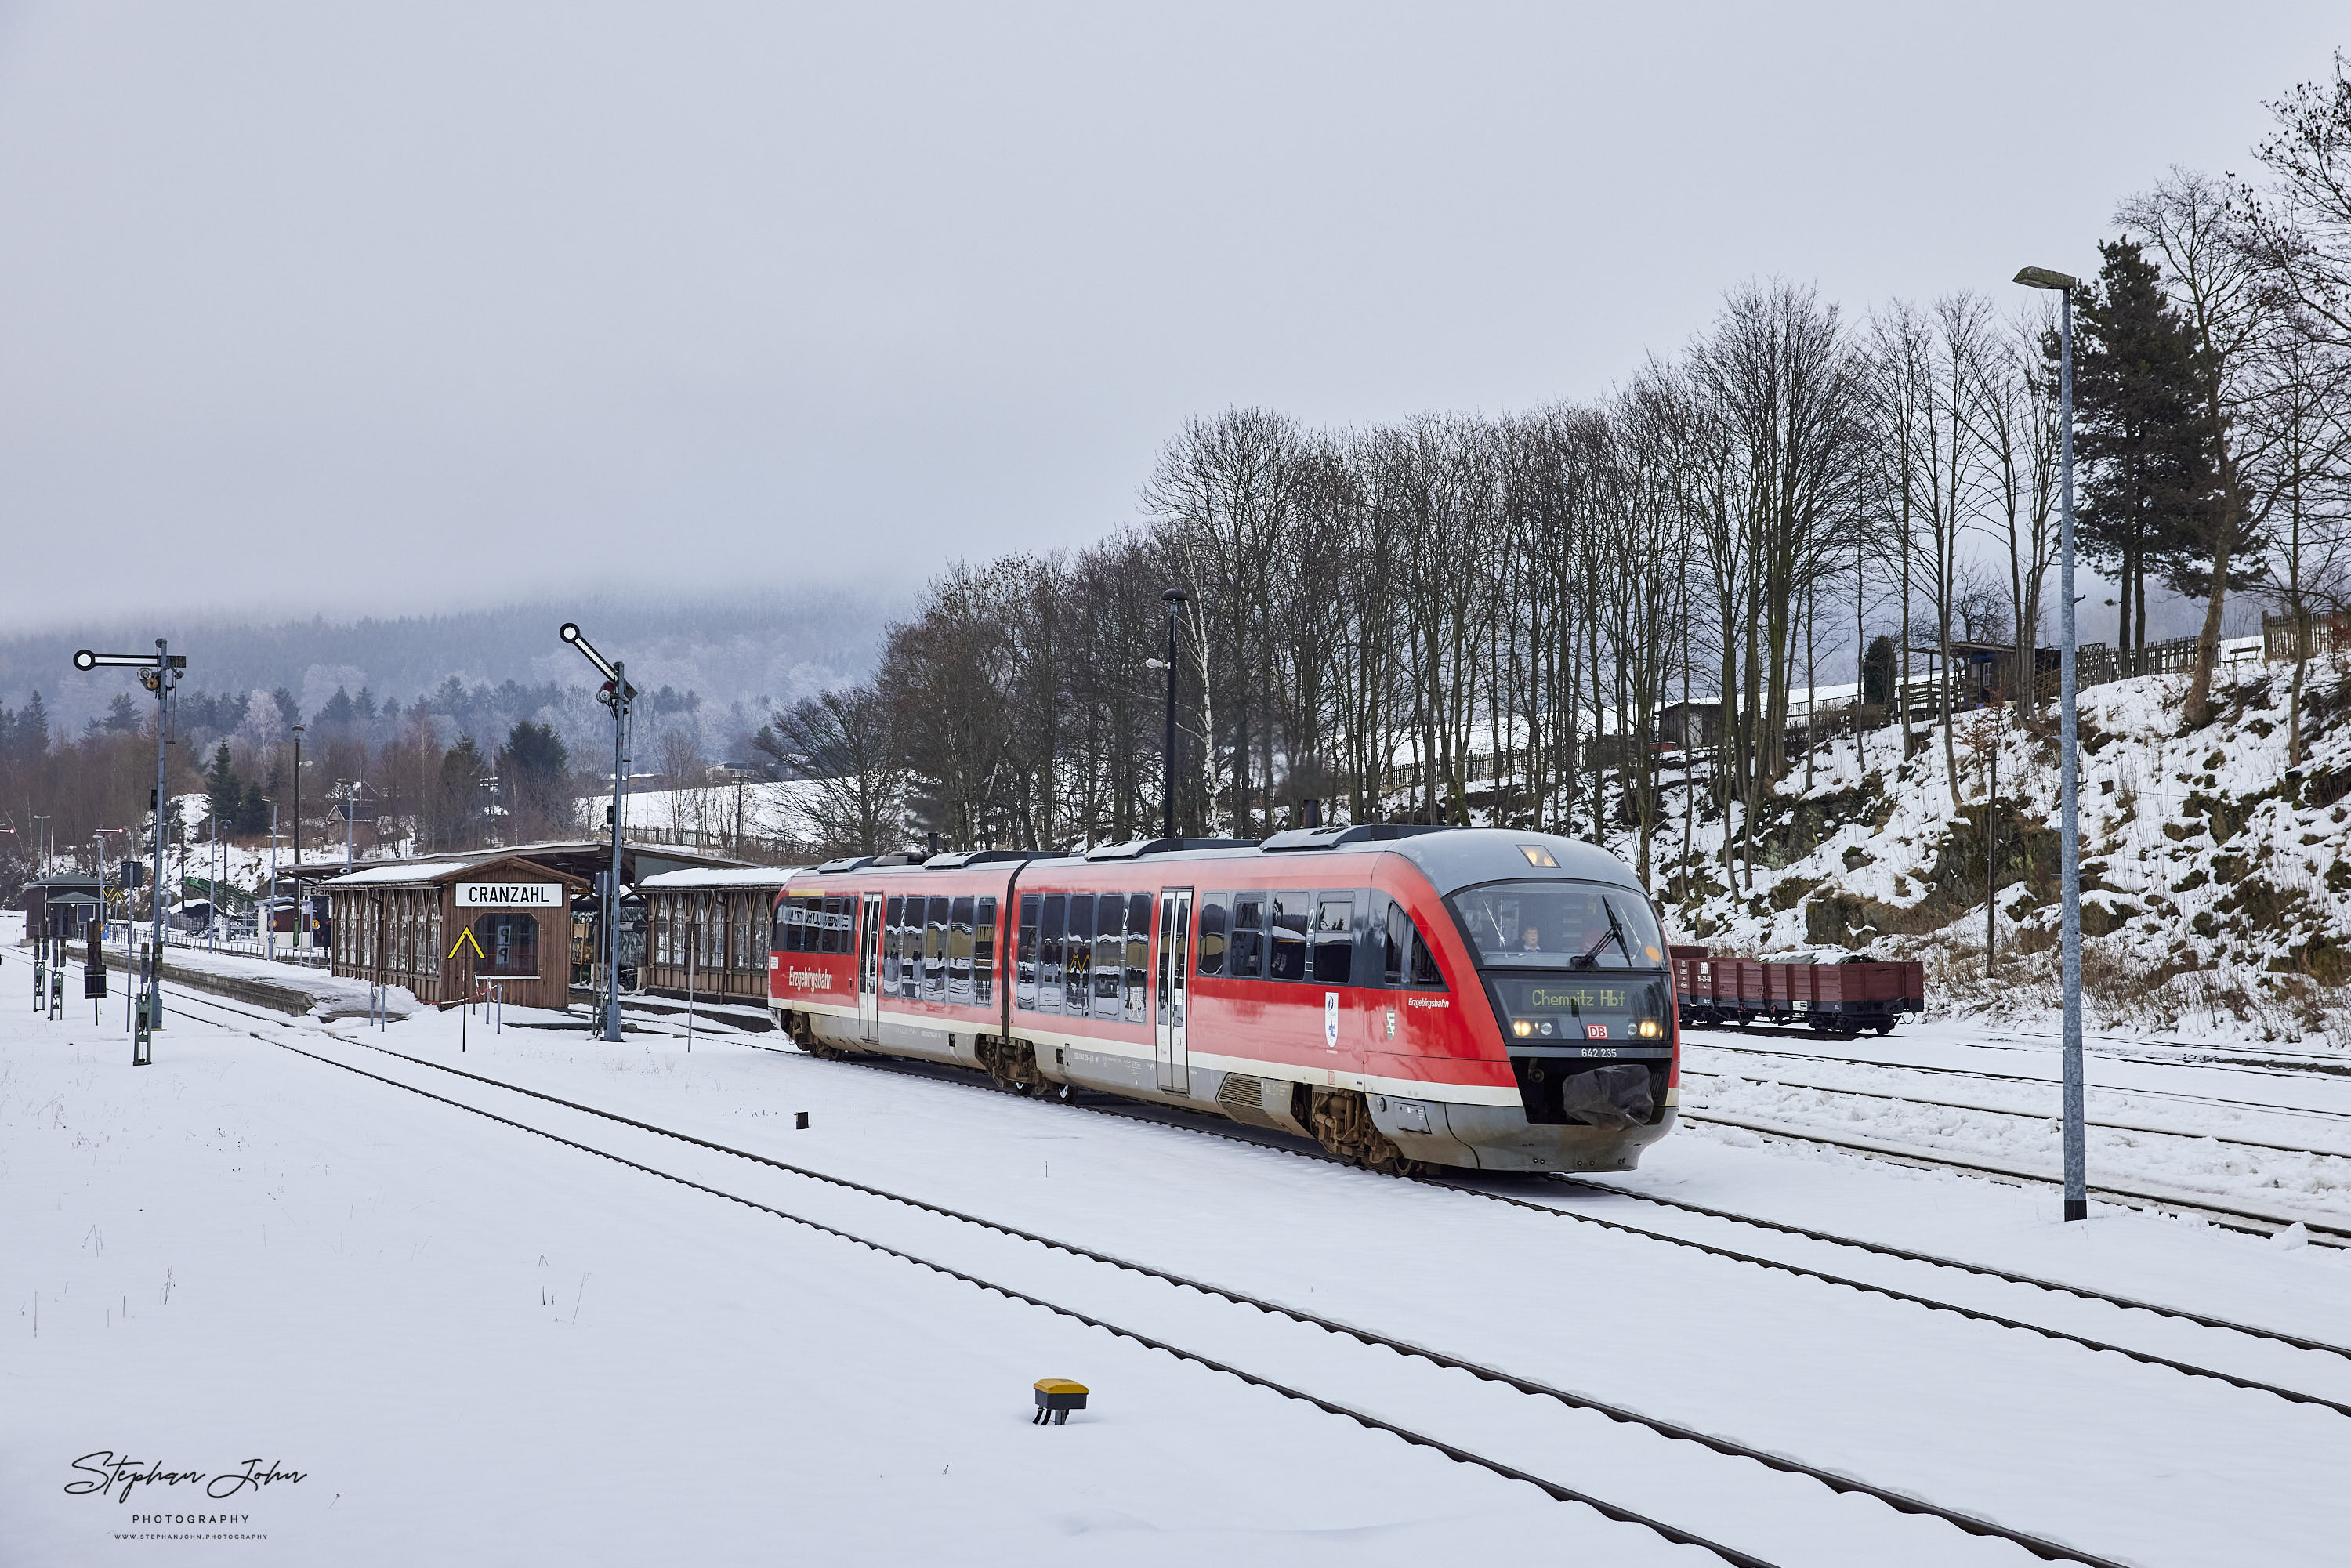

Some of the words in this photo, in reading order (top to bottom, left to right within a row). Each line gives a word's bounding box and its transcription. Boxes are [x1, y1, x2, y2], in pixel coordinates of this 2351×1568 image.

[469, 886, 549, 903] CRANZAHL
[900, 908, 905, 925] 2
[1123, 908, 1128, 929] 2
[1308, 908, 1315, 933] 2
[1700, 961, 1708, 974] DR
[788, 965, 832, 993] Erzgebirgsbahn
[1407, 997, 1450, 1009] Erzgebirgsbahn
[1531, 989, 1595, 1006] Chemnitz
[1600, 990, 1625, 1007] Hbf
[1589, 1027, 1607, 1037] DB
[1581, 1048, 1599, 1058] 642
[1601, 1048, 1617, 1058] 235
